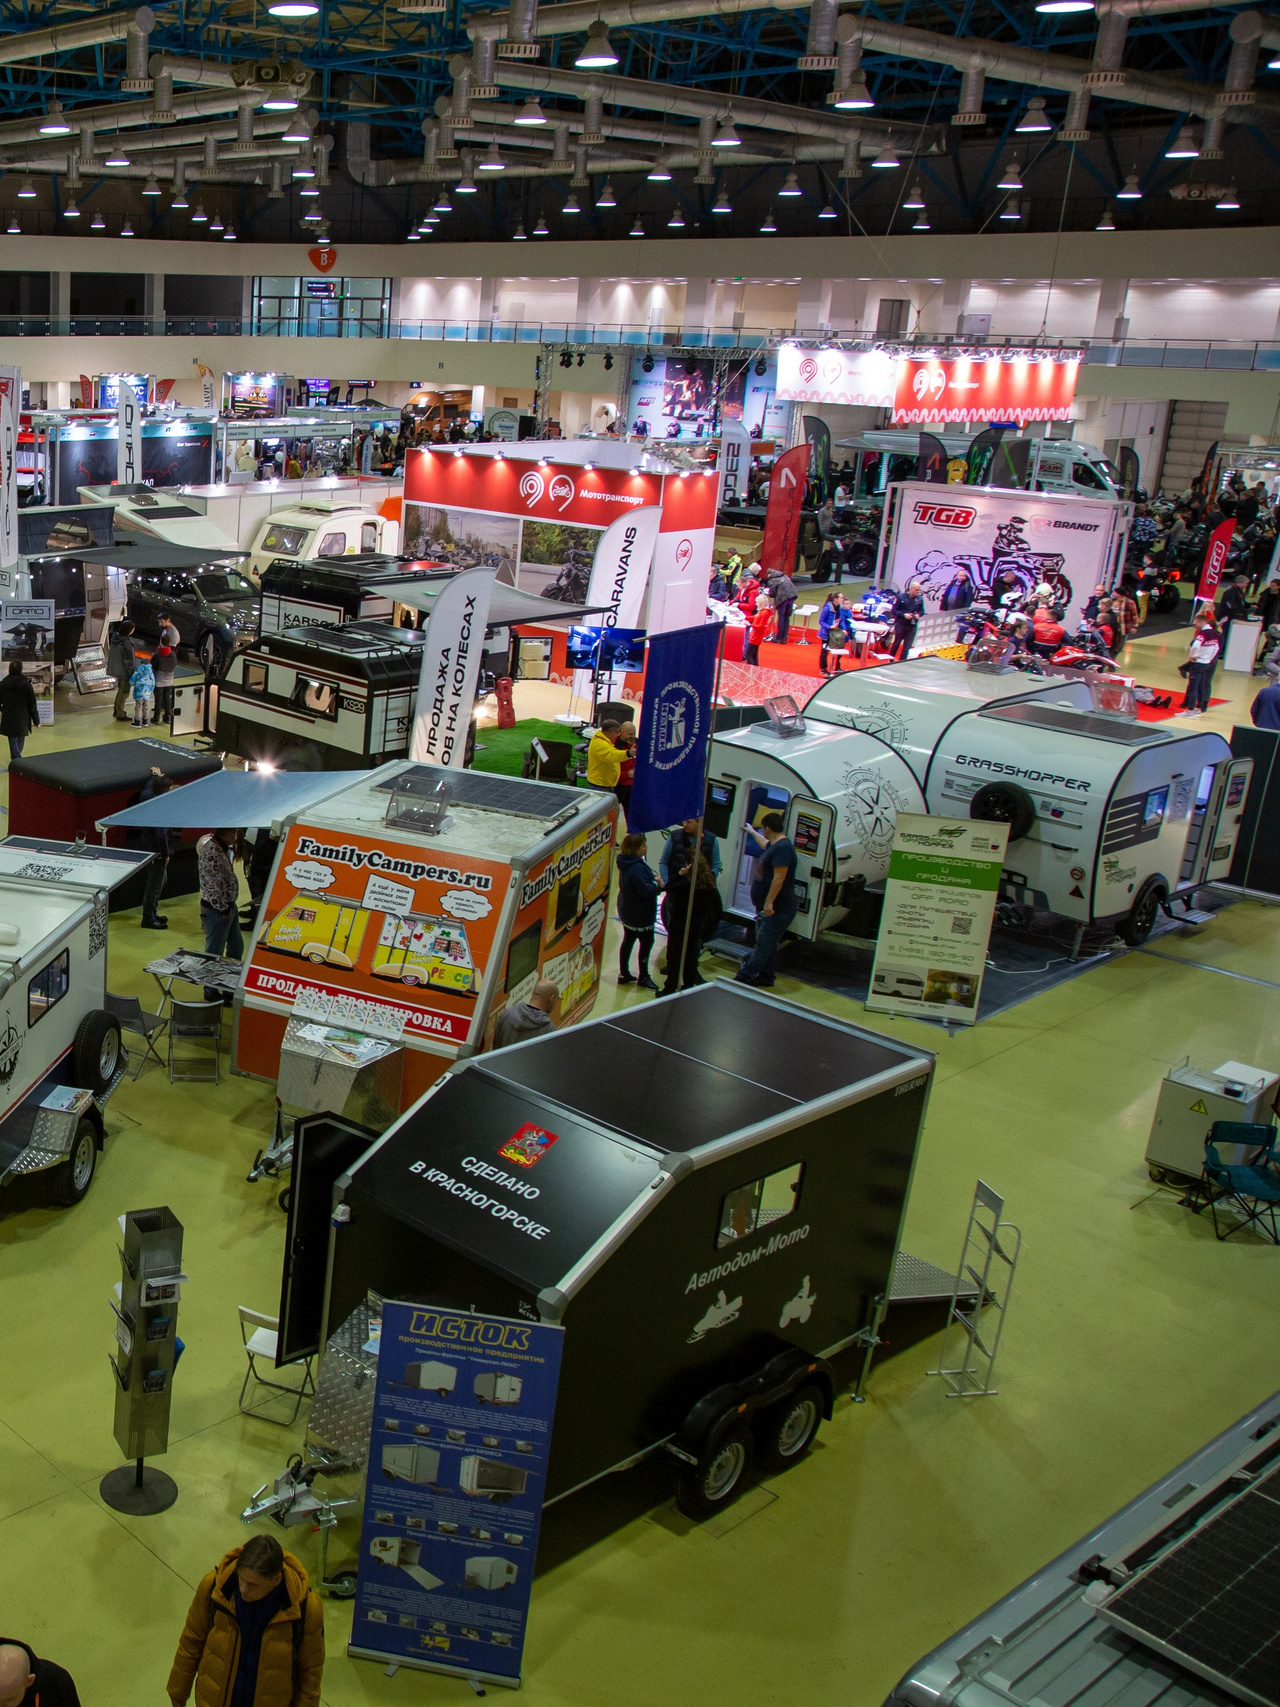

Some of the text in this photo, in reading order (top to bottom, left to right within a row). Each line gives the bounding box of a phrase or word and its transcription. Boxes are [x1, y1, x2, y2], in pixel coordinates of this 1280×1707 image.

[320, 252, 328, 265] B
[579, 488, 644, 506] Мототранспорт
[914, 503, 975, 528] TGB
[1052, 521, 1101, 532] BRANDT
[1206, 540, 1225, 586] TGB
[606, 526, 638, 628] CARAVANS
[283, 612, 329, 627] KARS
[442, 594, 477, 767] ОВ НА КОЛЕСАХ
[343, 698, 365, 713] KS29
[426, 647, 452, 756] ПРОДАЖА
[661, 681, 700, 734] ПРОИЗВОДСТВЕННОЕ
[649, 698, 659, 764] КРАСНОГОРСК
[955, 754, 1091, 793] GRASSHOPPER
[900, 832, 930, 840] GRASS
[917, 841, 955, 850] HOPPER
[297, 838, 491, 890] FamilyCampers.ru
[520, 822, 612, 909] FamilyCampers.ru
[902, 853, 992, 870] ПРОИЗВОДСТВО
[941, 866, 949, 874] И
[916, 873, 971, 885] ПРОДАЖА
[901, 885, 983, 899] ЖИЛЫХ ПРИЦЕПОВ
[938, 896, 969, 906] ROAD
[920, 905, 978, 918] ПУТЕШЕСТВИЙ
[278, 925, 301, 936] Family
[431, 967, 470, 985] PEACE
[894, 1074, 927, 1097] THERMO
[460, 1156, 541, 1200] СДЕЛАНО
[409, 1160, 551, 1240] В КРАСНОГОРСКЕ
[684, 1225, 811, 1295] Автодом-Мото
[410, 1311, 532, 1350] ИСТОК
[399, 1335, 546, 1364] производственное предприятие
[476, 1449, 503, 1458] БИЗНЕСА
